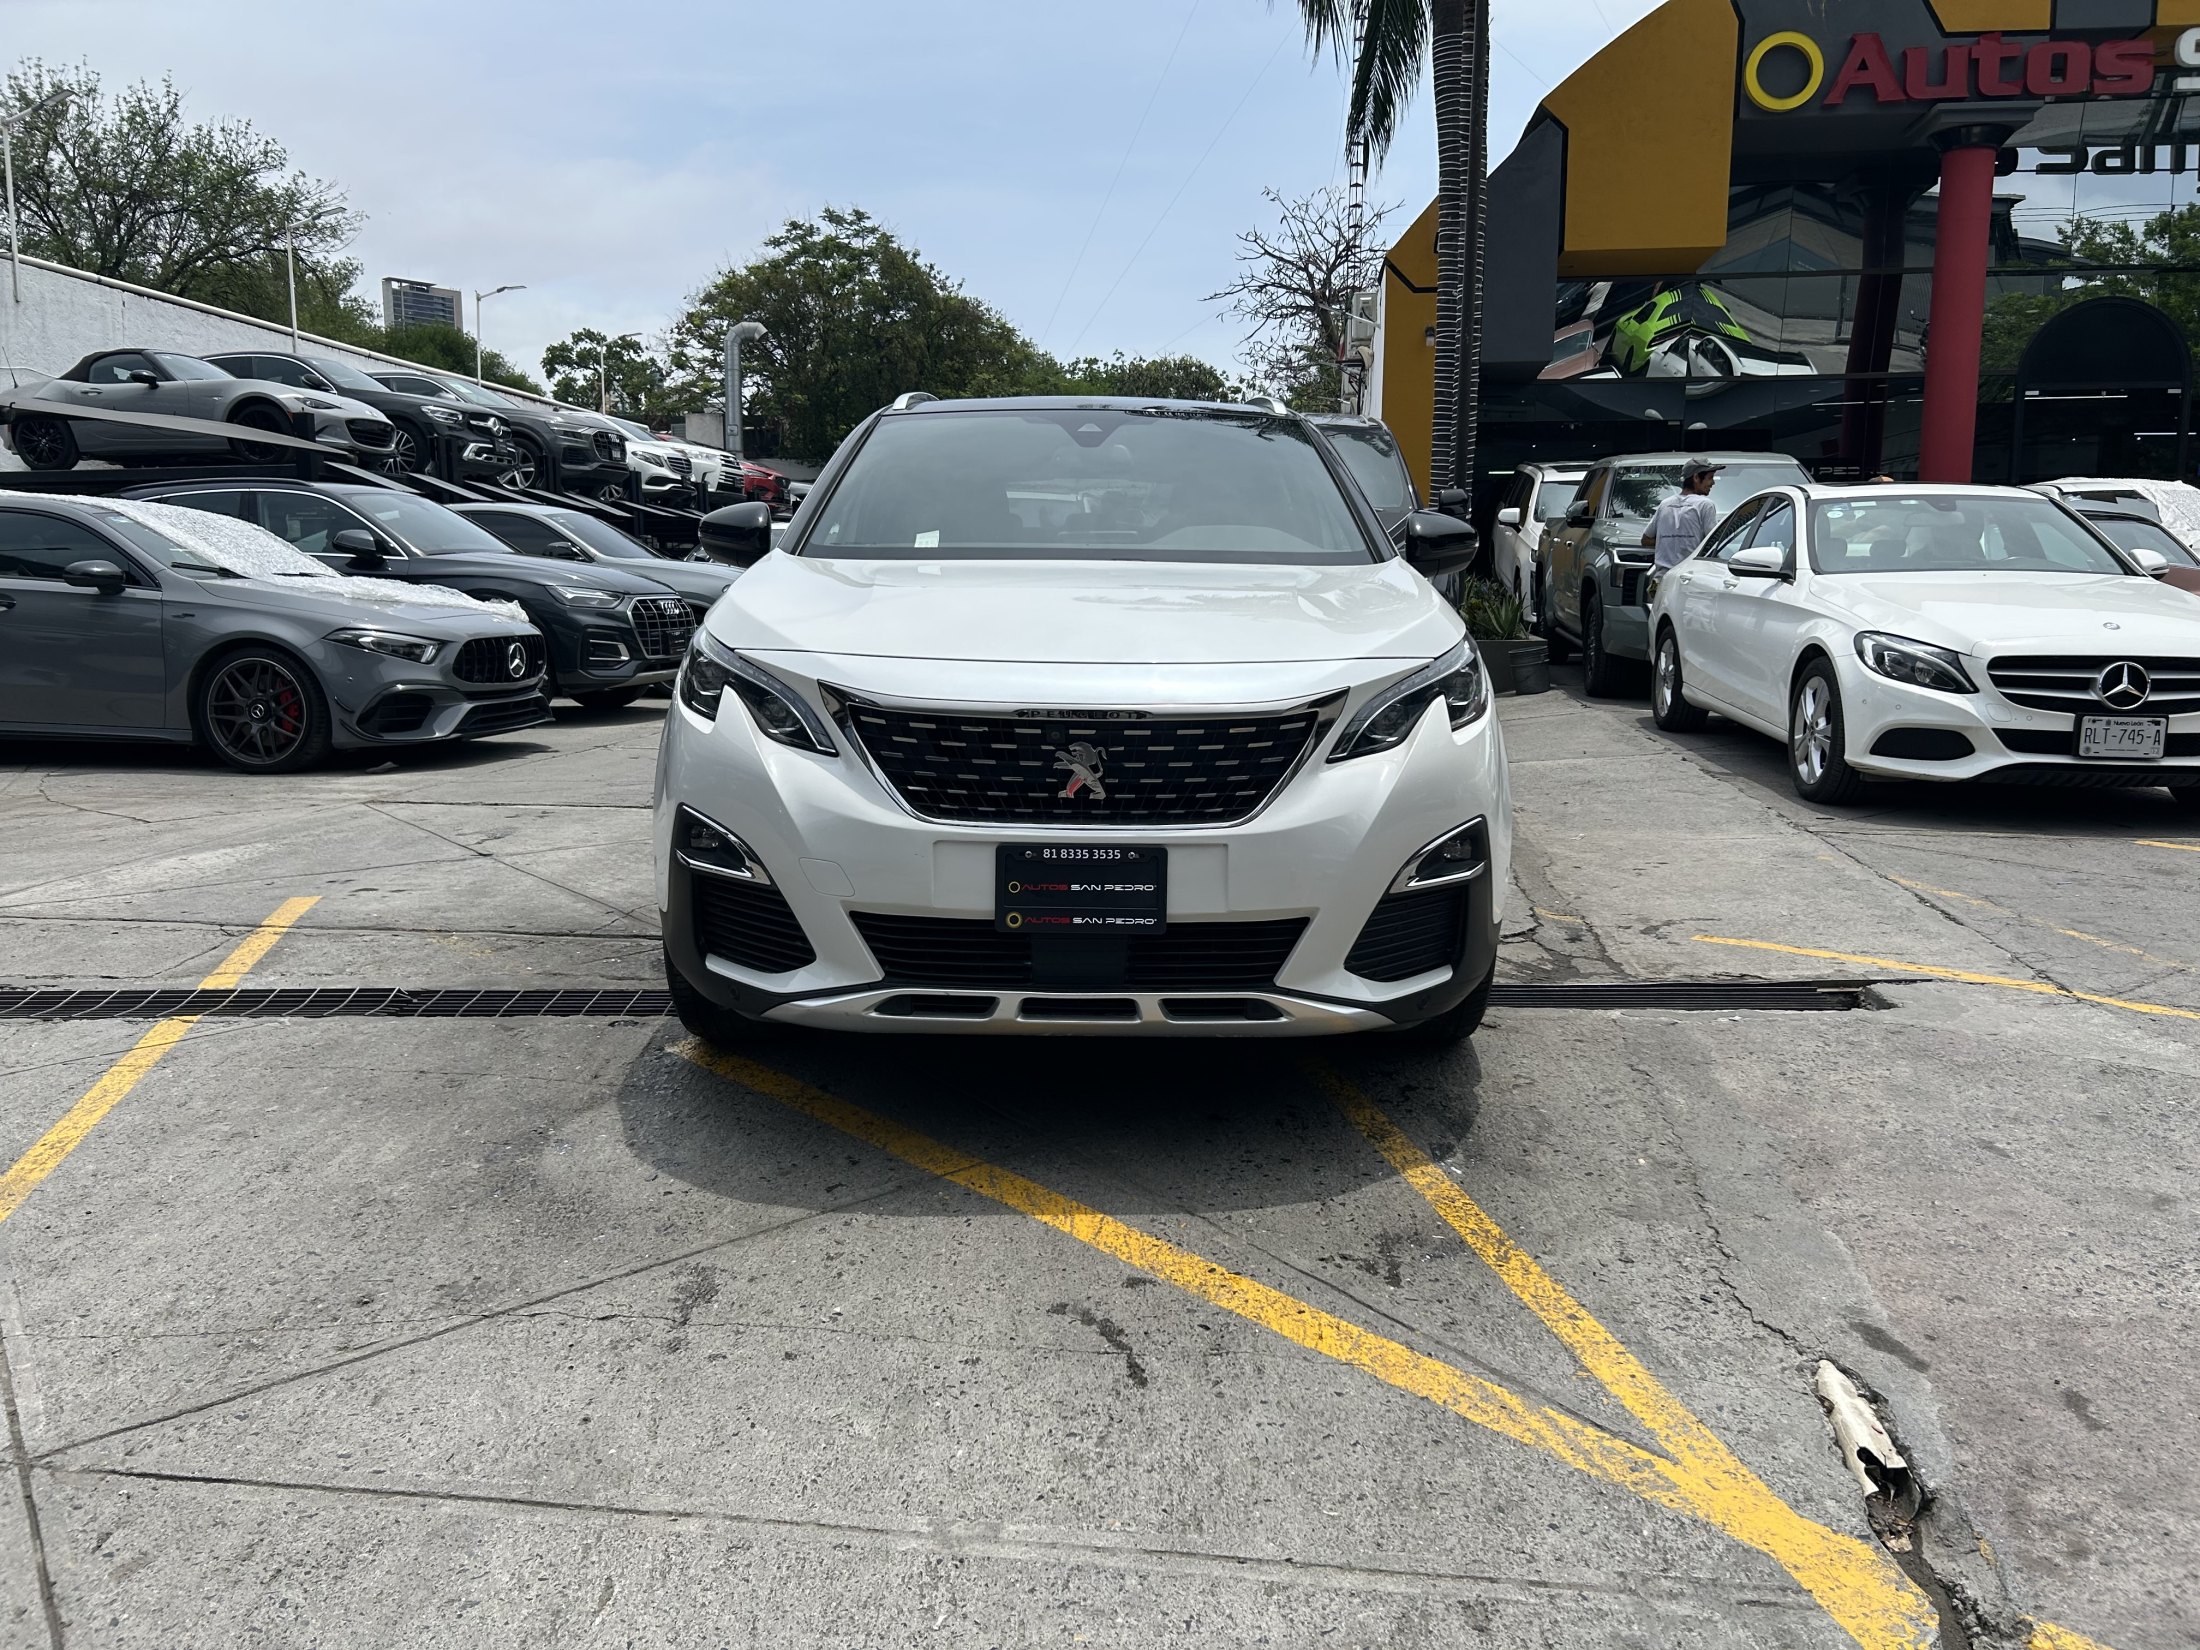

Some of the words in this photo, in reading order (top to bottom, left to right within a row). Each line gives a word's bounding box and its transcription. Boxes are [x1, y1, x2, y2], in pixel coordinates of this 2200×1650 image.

[1825, 33, 2155, 104] Autos
[2084, 727, 2161, 746] RLT-745-A
[1043, 848, 1057, 859] 81
[1060, 848, 1089, 859] 8335
[1092, 849, 1121, 860] 3535
